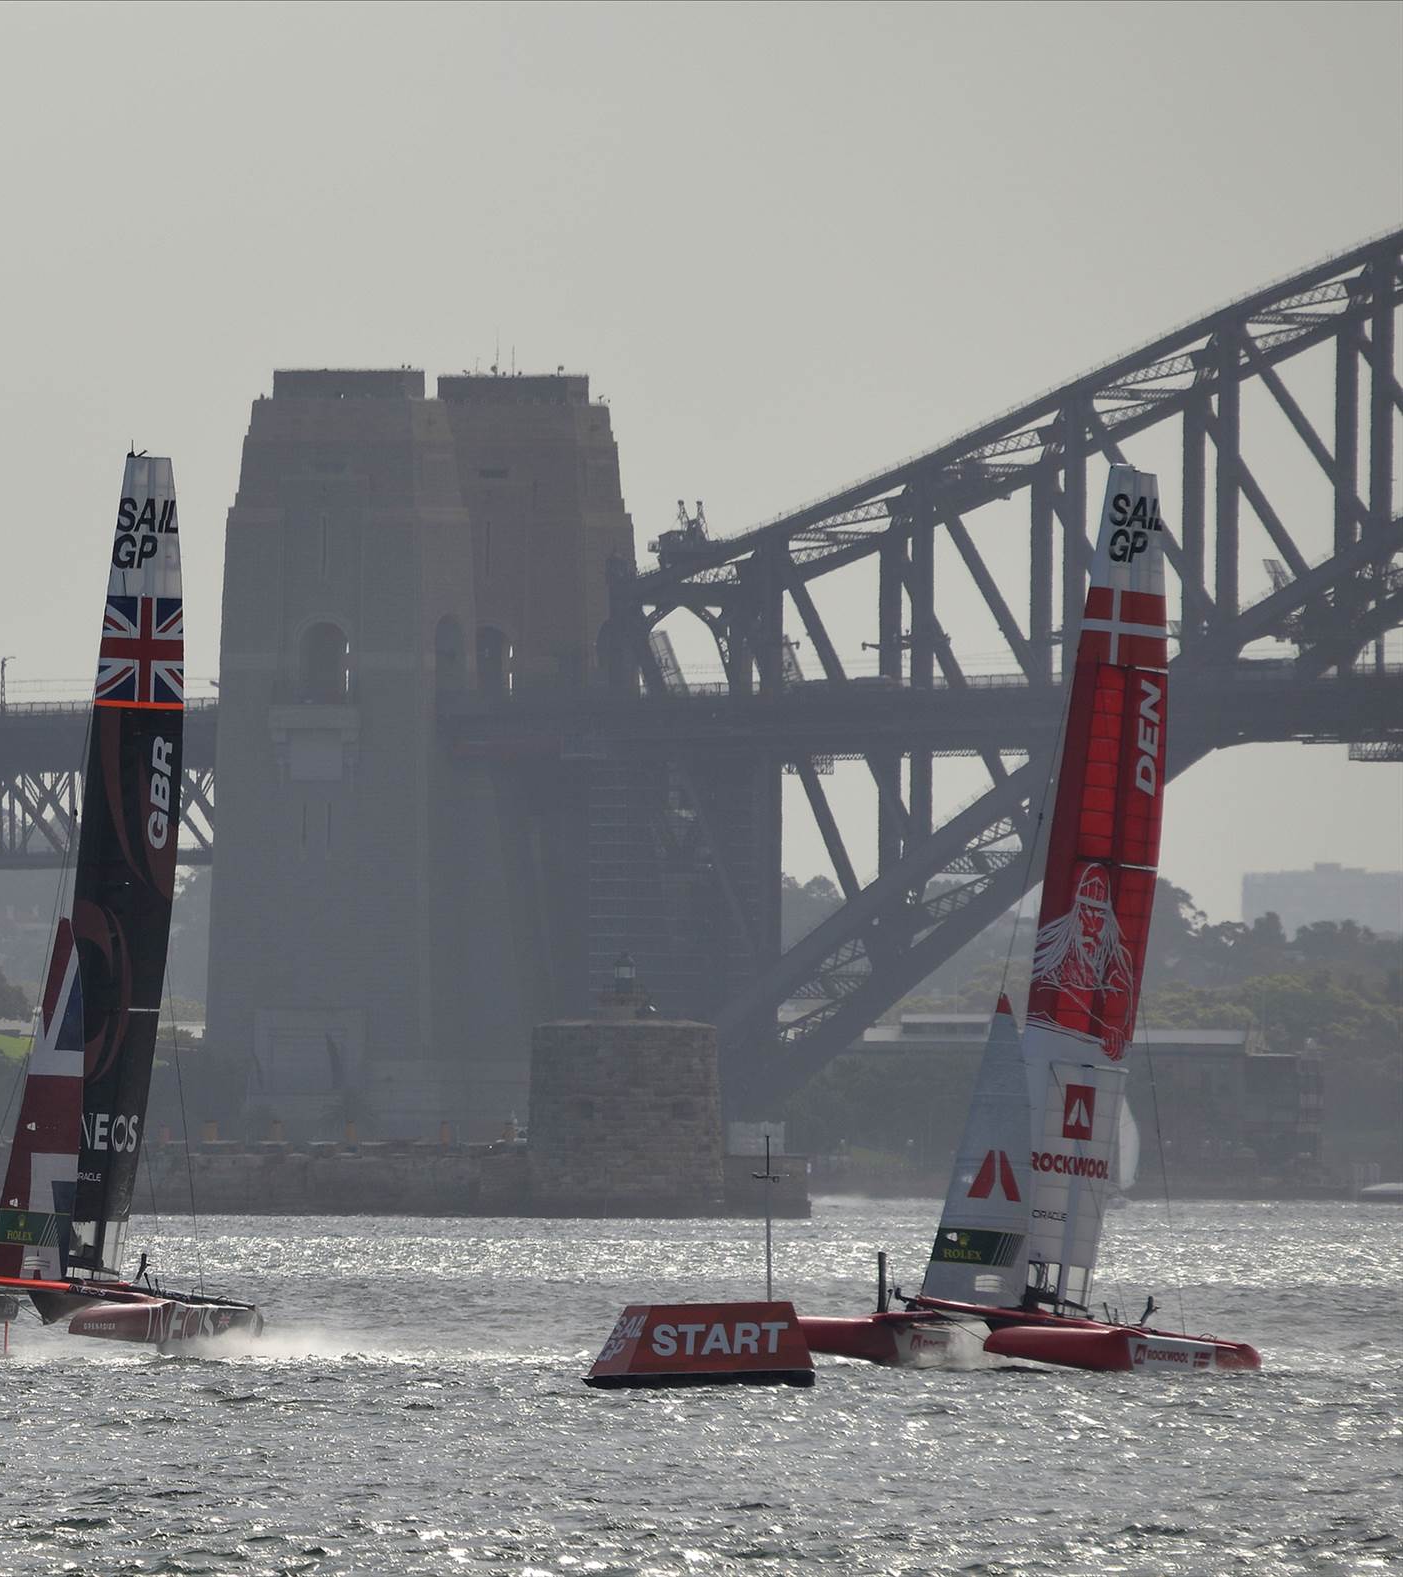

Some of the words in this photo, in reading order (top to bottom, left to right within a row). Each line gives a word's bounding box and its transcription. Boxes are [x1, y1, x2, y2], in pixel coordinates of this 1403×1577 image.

[117, 497, 178, 533] SAIL
[112, 534, 158, 569] GP
[1109, 529, 1149, 563] GP
[1136, 679, 1162, 797] DEN
[148, 736, 173, 850] GBR
[80, 1112, 139, 1152] NEOS
[76, 1171, 101, 1182] RACLE
[1031, 1151, 1109, 1180] ROCKWOOL
[1031, 1209, 1068, 1222] ORACLE
[6, 1230, 32, 1241] ROLEX
[943, 1248, 982, 1260] ROLEX
[611, 1315, 647, 1339] SAIL
[651, 1321, 789, 1357] START
[598, 1338, 627, 1362] GP
